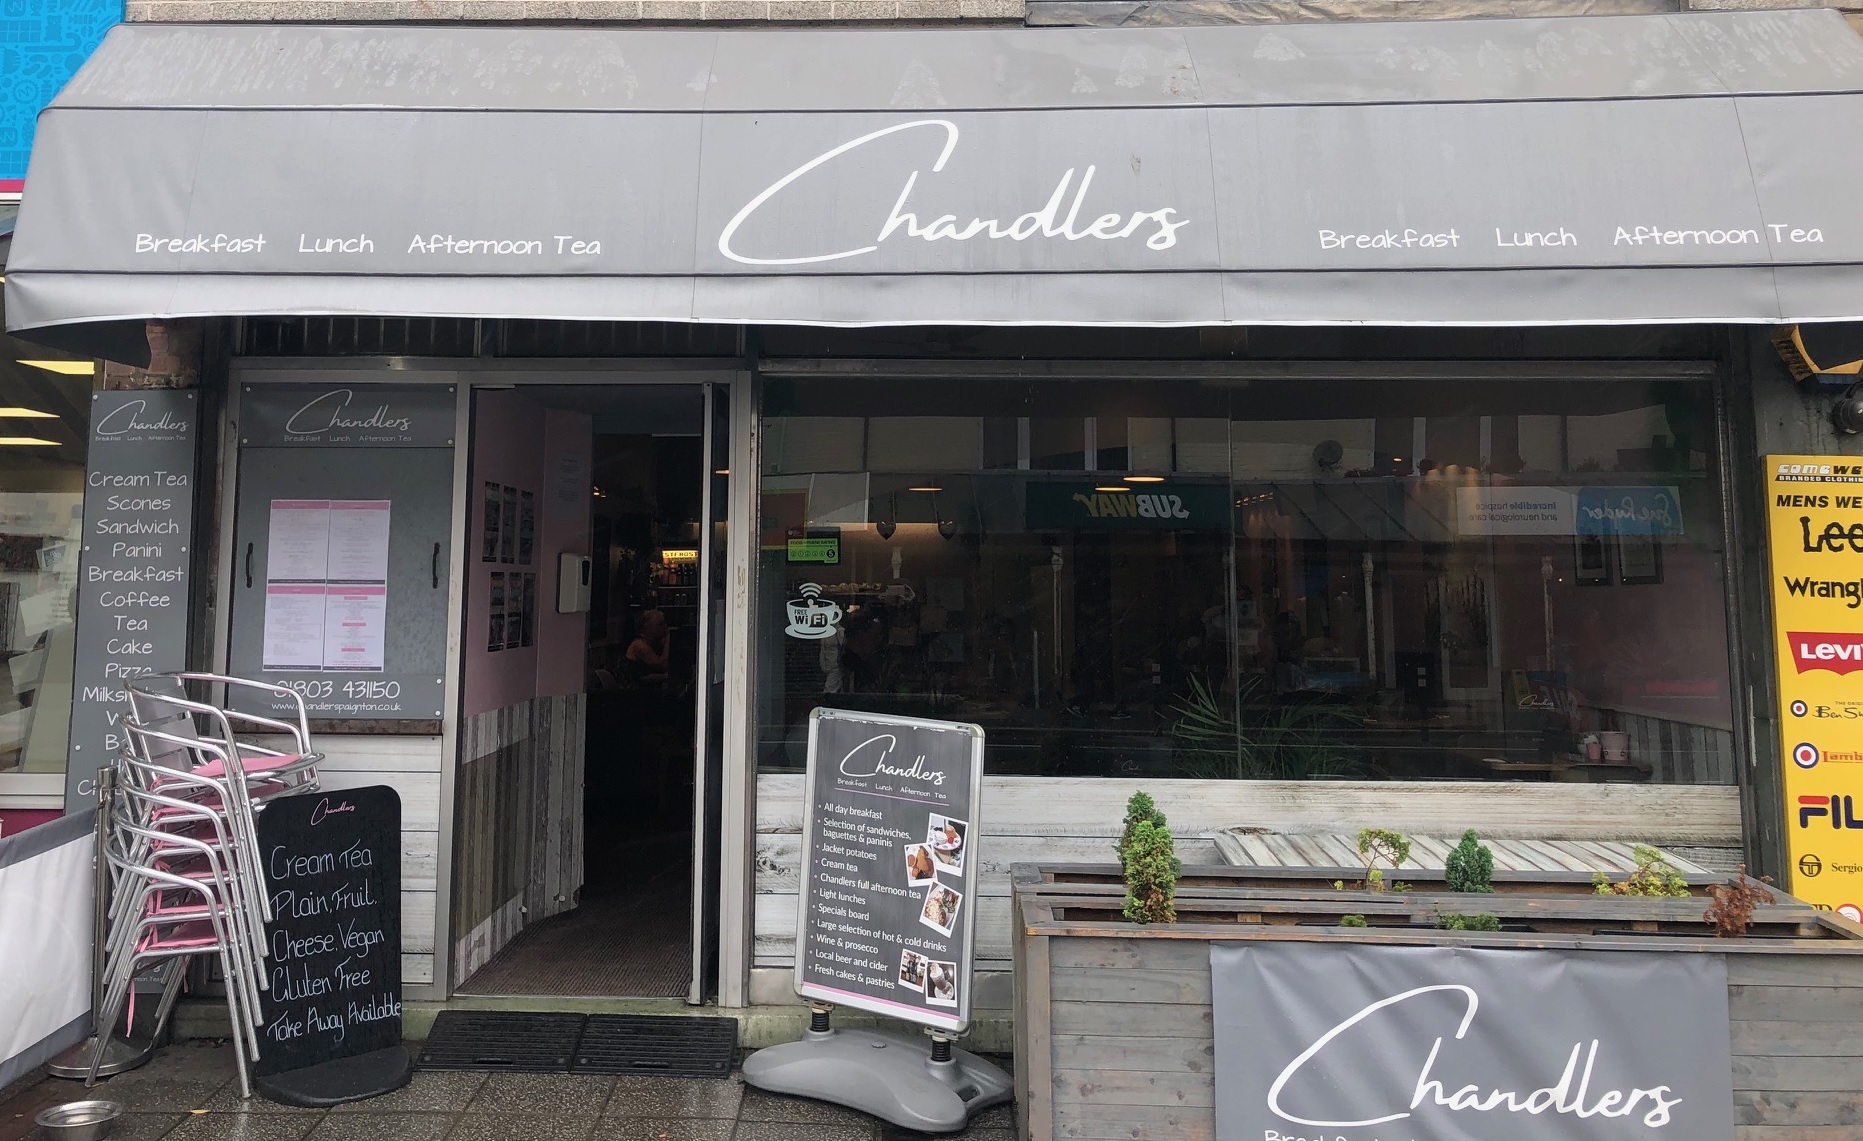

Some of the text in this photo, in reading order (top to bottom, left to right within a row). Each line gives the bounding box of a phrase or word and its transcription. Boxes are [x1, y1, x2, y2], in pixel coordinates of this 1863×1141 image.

[718, 119, 1190, 265] Chandlers
[135, 233, 601, 256] Breakfast Lunch Afternoon Tea
[1319, 223, 1824, 250] Breakfast Lunch Afternoon Tea
[97, 400, 189, 435] Chandlers
[285, 389, 412, 434] Chandlers
[89, 471, 187, 487] Cream Tea
[106, 495, 171, 510] Scones
[1776, 495, 1863, 508] MENS WE
[96, 518, 179, 534] Sandwich
[1799, 516, 1863, 553] Lee
[112, 542, 162, 557] Panini
[88, 566, 184, 582] Breakfast
[100, 591, 171, 607] Coffee
[1783, 576, 1863, 609] Wrangl
[113, 615, 148, 631] Tea
[106, 638, 153, 654] Cake
[274, 680, 401, 699] 01803 431150
[271, 702, 402, 715] www.candlerspaignton.co.uk
[1812, 706, 1843, 719] Ben
[839, 734, 946, 785] Chandlers
[1822, 751, 1863, 764] Lamb
[837, 777, 868, 788] Breakfast
[875, 783, 893, 792] Lunch
[900, 787, 931, 797] Afternoon
[311, 798, 356, 826] Chandlers
[824, 803, 882, 820] All day breakfast
[1798, 795, 1863, 830] FIL
[823, 818, 912, 841] Selection of sandwiches,
[823, 828, 893, 848] baguettes & paninis
[271, 839, 373, 880] Cream Tea
[822, 843, 877, 861] Jacket potatoes
[821, 858, 858, 872] Cream tea
[1831, 862, 1863, 875] Sergio
[820, 872, 921, 900] Chandlers full afternoon tea
[819, 888, 866, 905] Light lunches
[818, 903, 870, 921] Specials board
[337, 918, 385, 958] Vegan
[816, 934, 878, 955] Wine & prosecco
[817, 918, 947, 953] Large selection of hot & cold drinks
[815, 949, 888, 972] Local beer and cider
[272, 956, 371, 1002] Gluten Free
[814, 964, 895, 989] Fresh cakes & pastries
[267, 992, 402, 1042] Take Away Available
[1267, 985, 1682, 1127] Chandlers
